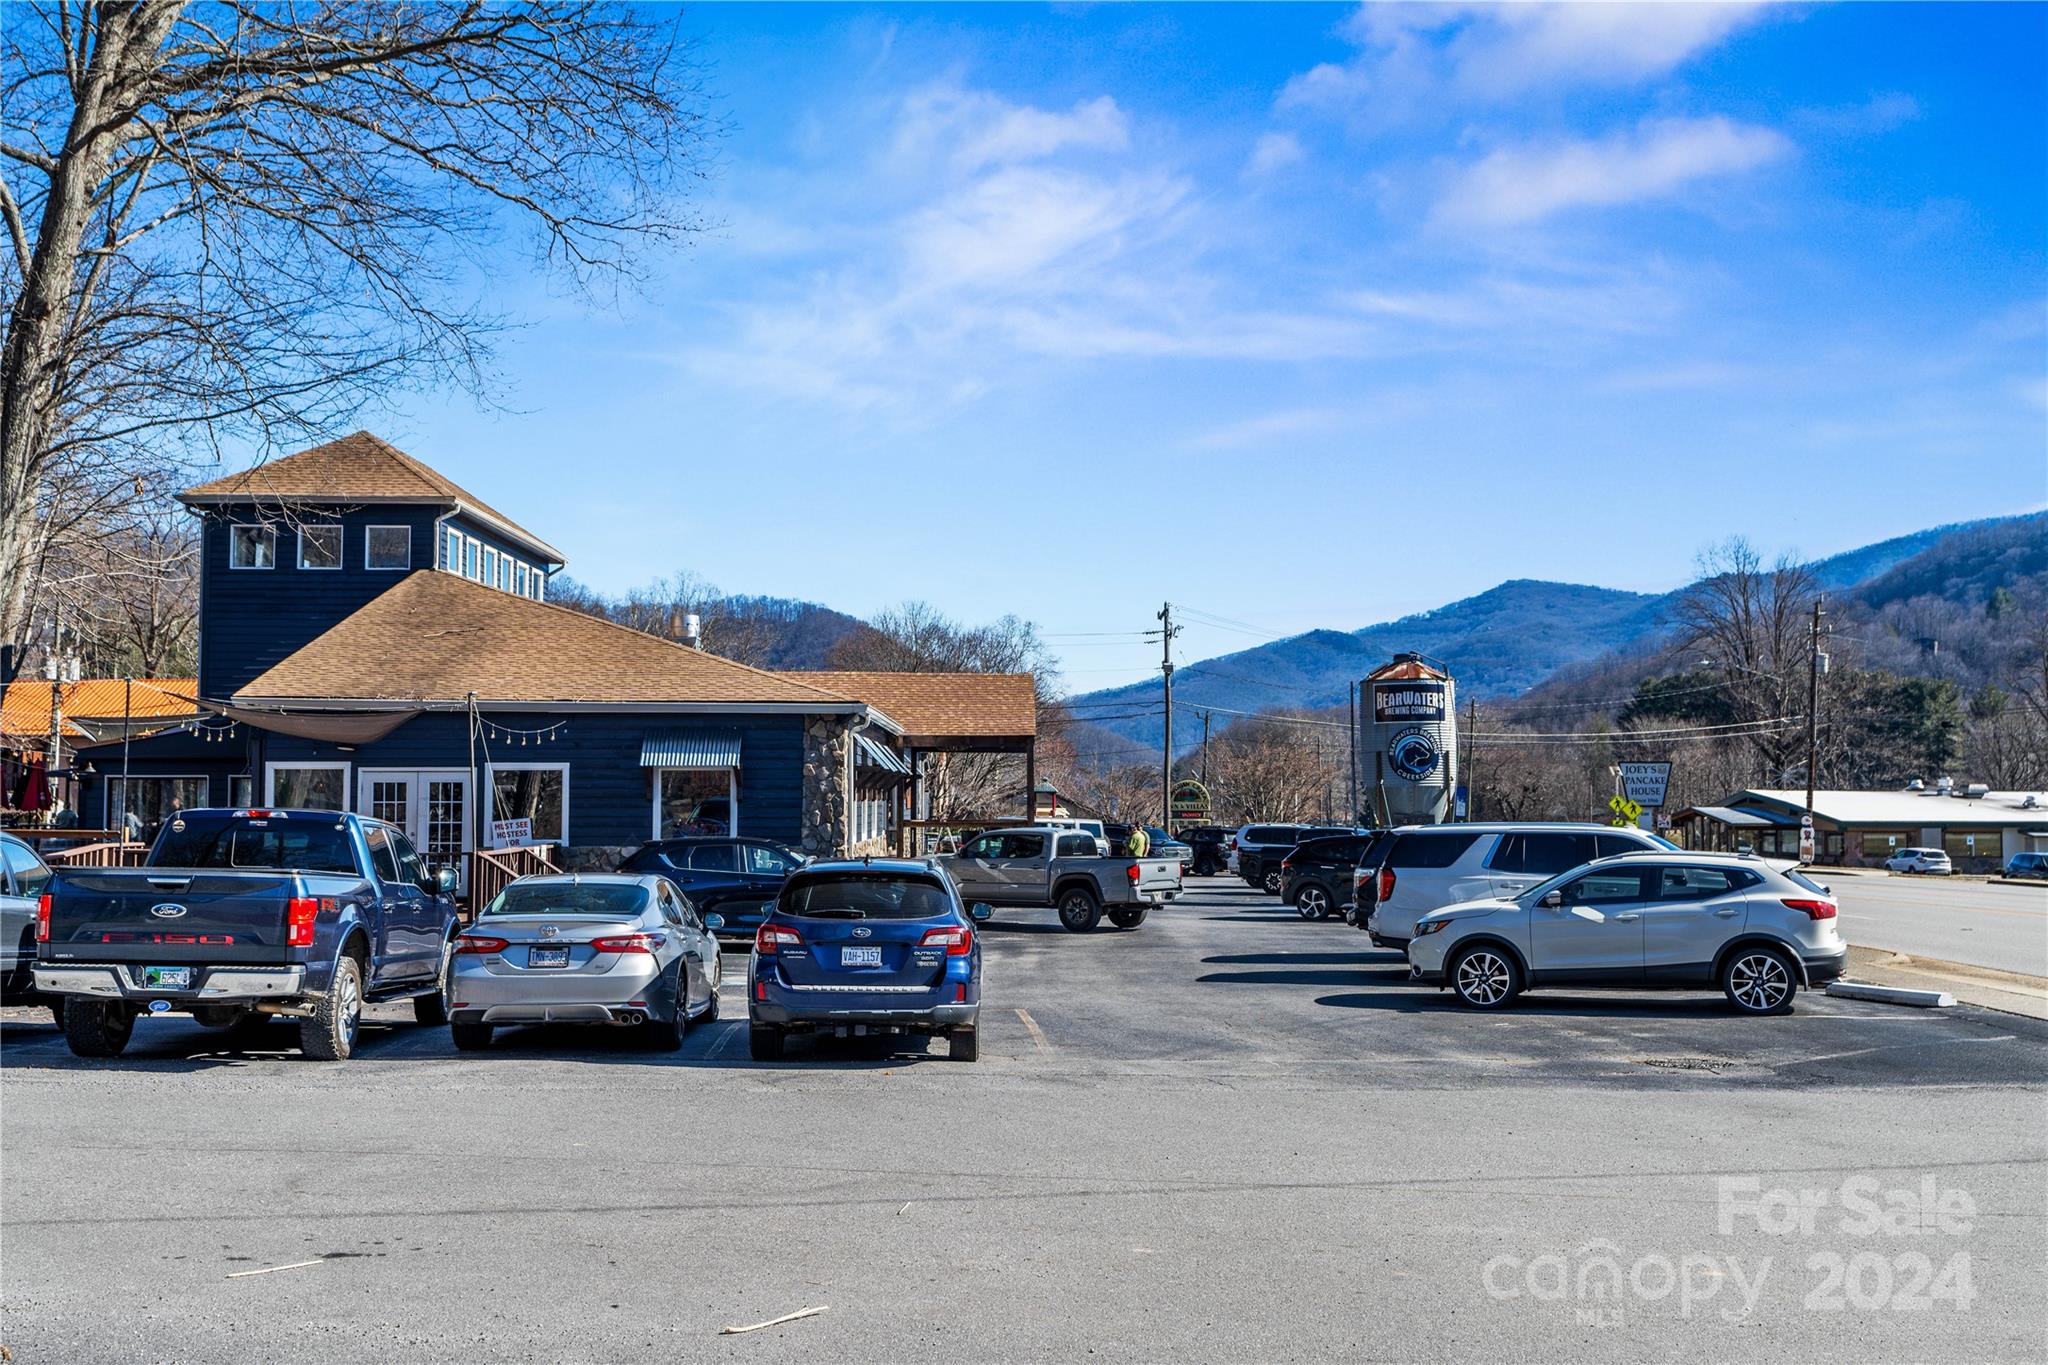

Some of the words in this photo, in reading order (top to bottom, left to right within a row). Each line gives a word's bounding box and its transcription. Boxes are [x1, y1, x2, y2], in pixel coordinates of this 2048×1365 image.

[1376, 691, 1444, 710] BEARWATERS
[1384, 706, 1410, 715] BREWING
[1411, 705, 1437, 714] COMPANY
[1389, 728, 1419, 756] BEARWATERS
[1397, 767, 1434, 780] CREEKSIDE
[1625, 765, 1657, 775] JOEY'S
[1625, 776, 1667, 785] PANCAKE
[1631, 787, 1661, 796] HOUSE
[494, 822, 514, 831] MUST
[515, 821, 528, 829] SEE
[496, 829, 528, 839] HOSTESS
